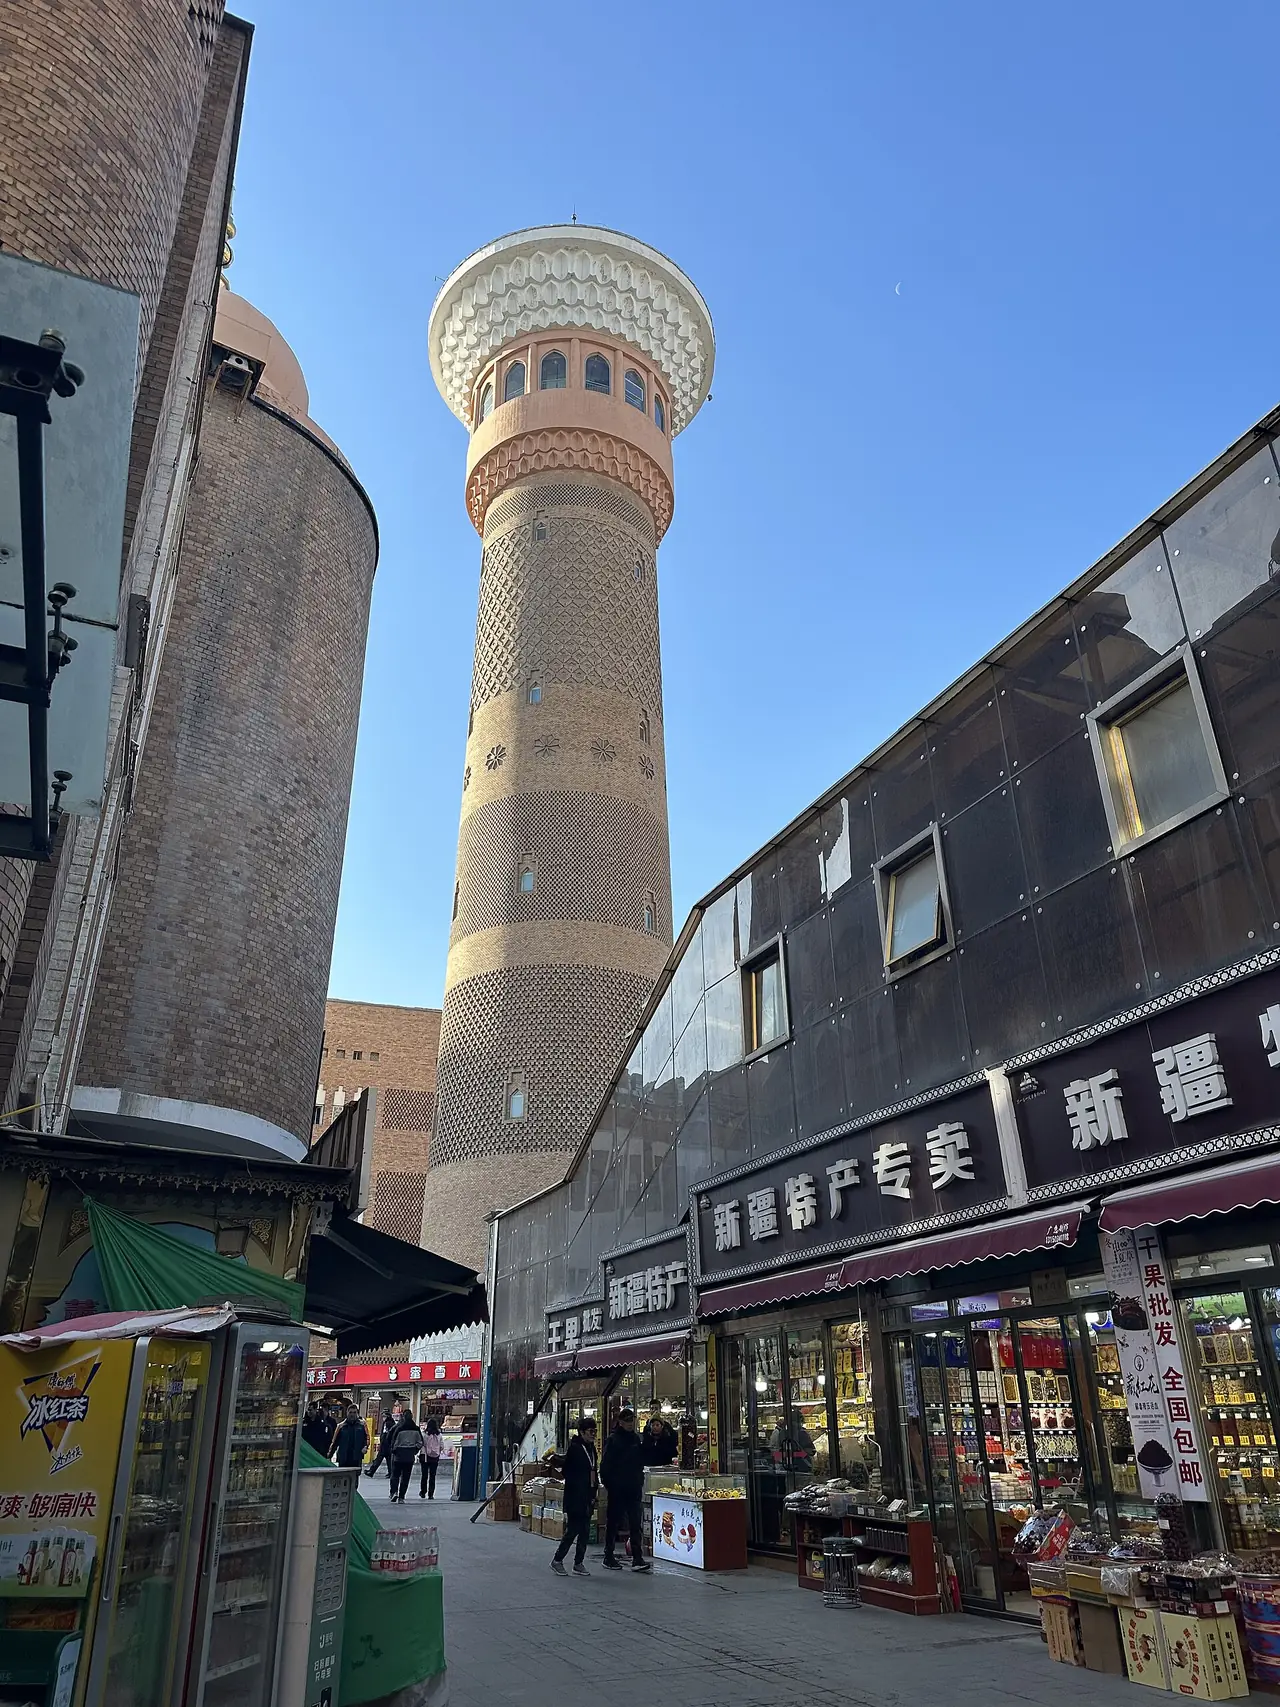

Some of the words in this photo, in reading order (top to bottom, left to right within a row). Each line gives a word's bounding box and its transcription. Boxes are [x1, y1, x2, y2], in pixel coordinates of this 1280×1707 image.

[714, 1122, 975, 1252] 新疆特产专卖
[608, 1261, 688, 1320] 新疆特产
[409, 1364, 472, 1380] 蜜雪冰
[1138, 1236, 1177, 1347] 干果批发
[1162, 1366, 1203, 1487] 全国包邮
[21, 1396, 89, 1437] 冰红茶
[0, 1491, 97, 1519] 爽·够痛快
